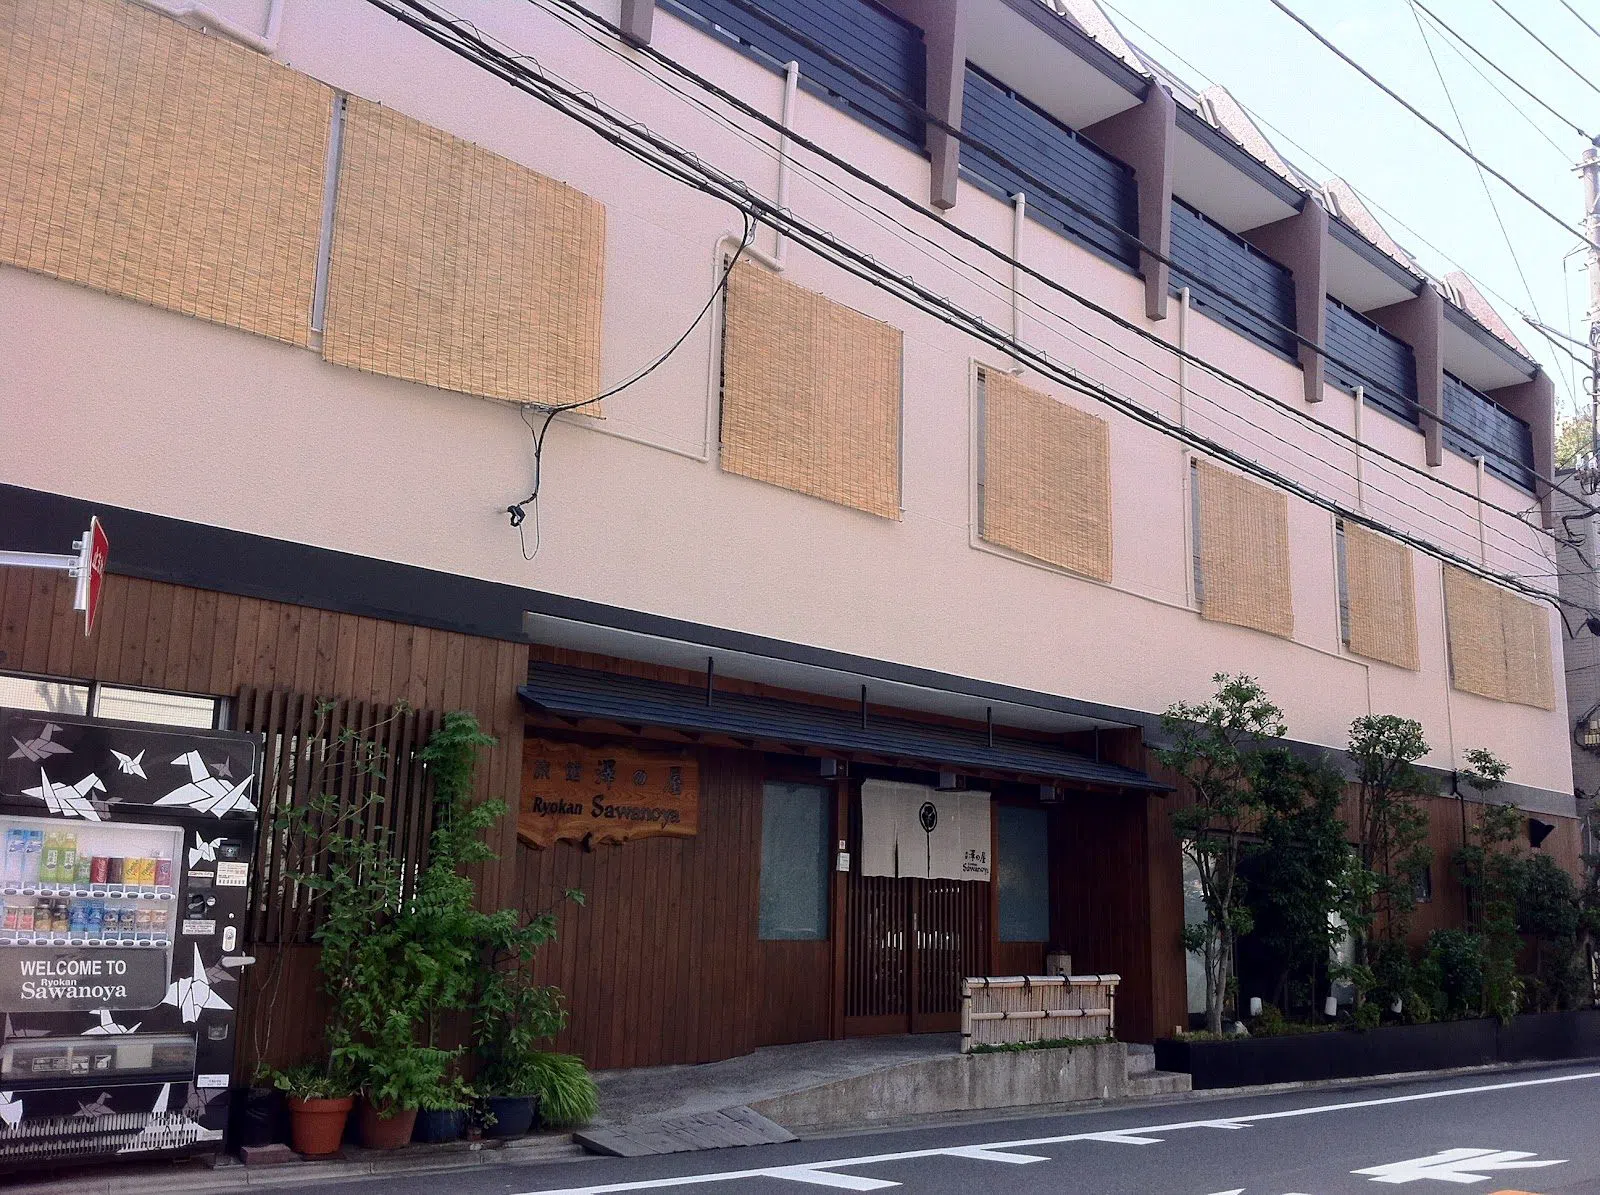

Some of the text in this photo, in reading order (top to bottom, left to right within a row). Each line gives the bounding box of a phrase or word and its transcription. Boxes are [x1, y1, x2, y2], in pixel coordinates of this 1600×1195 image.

[532, 794, 681, 830] Ryokan Sawanoya
[20, 959, 127, 976] WELCOME TO
[20, 981, 128, 1001] Sawanoya
[41, 978, 77, 987] Ryokan
